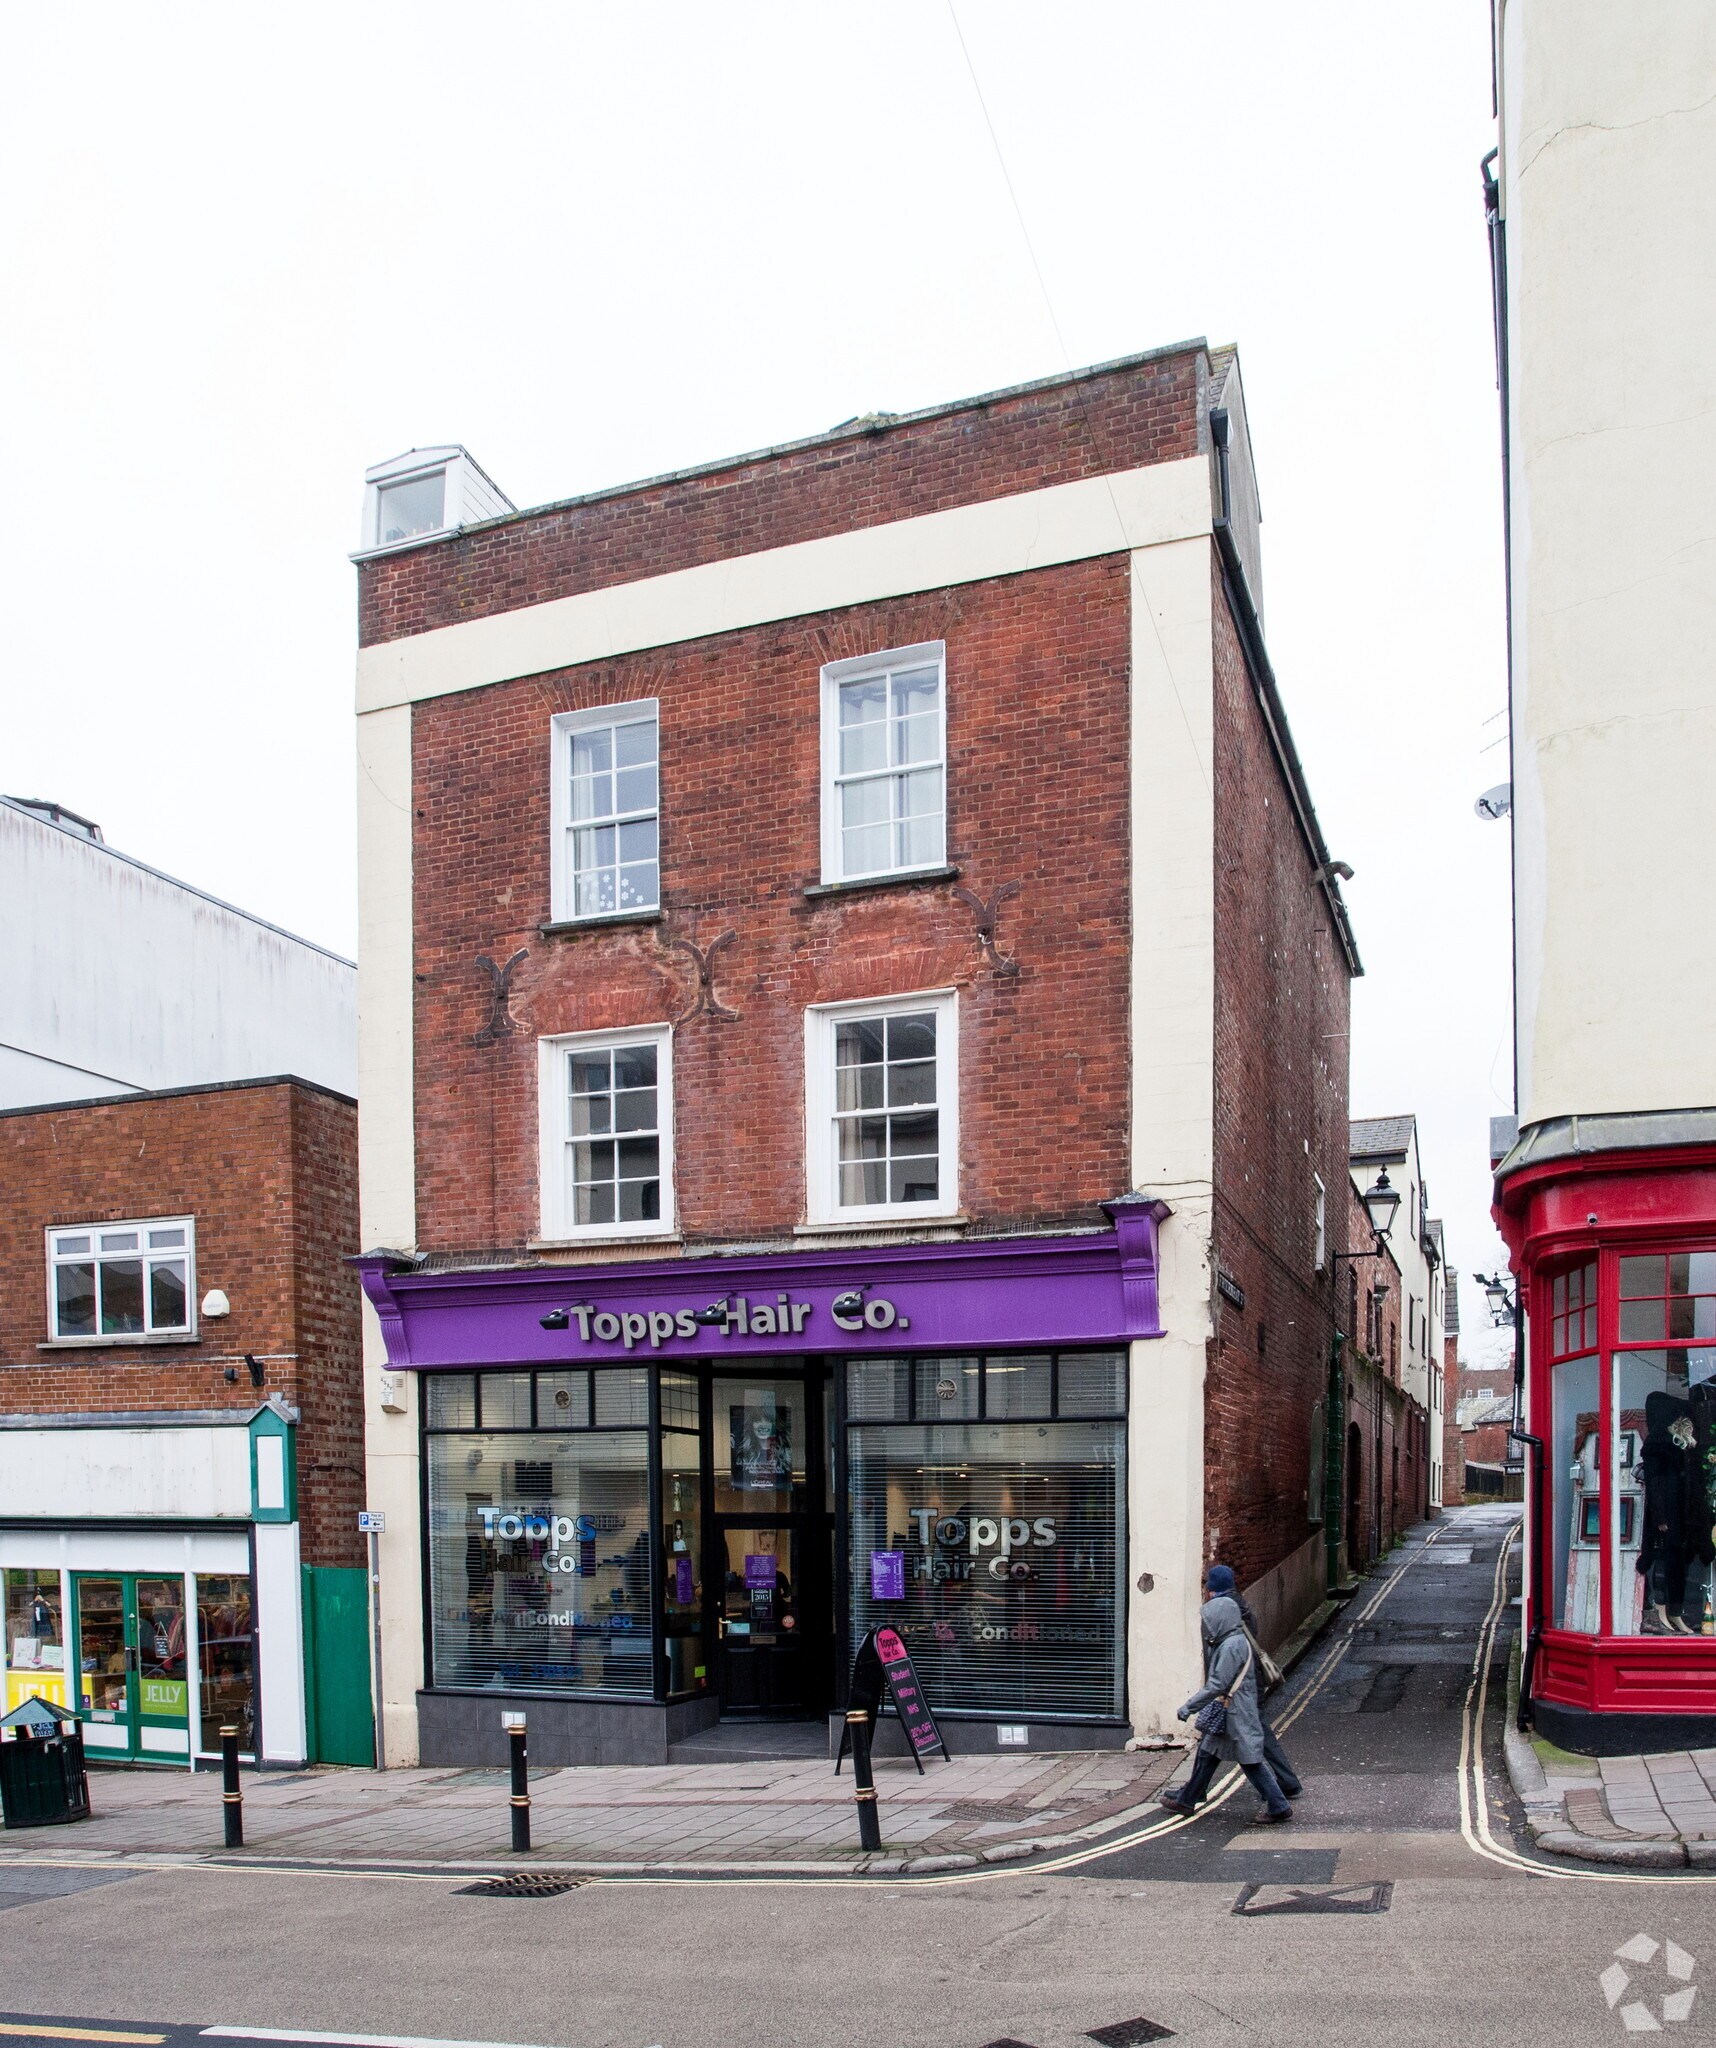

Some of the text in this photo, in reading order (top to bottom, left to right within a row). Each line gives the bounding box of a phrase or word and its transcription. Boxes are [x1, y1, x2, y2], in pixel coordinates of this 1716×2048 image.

[571, 1291, 909, 1348] Topps Hair Co.
[477, 1507, 597, 1551] Topps
[909, 1507, 1058, 1556] Topps
[479, 1548, 584, 1574] Hair Co.
[912, 1555, 976, 1582] Hair
[988, 1555, 1040, 1582] Co.
[967, 1621, 1101, 1641] Conditioned
[879, 1637, 899, 1650] Topps
[890, 1668, 911, 1681] Student
[145, 1684, 182, 1704] JELLY
[897, 1687, 917, 1699] Military
[906, 1702, 920, 1715] NHS
[914, 1732, 937, 1748] Discount
